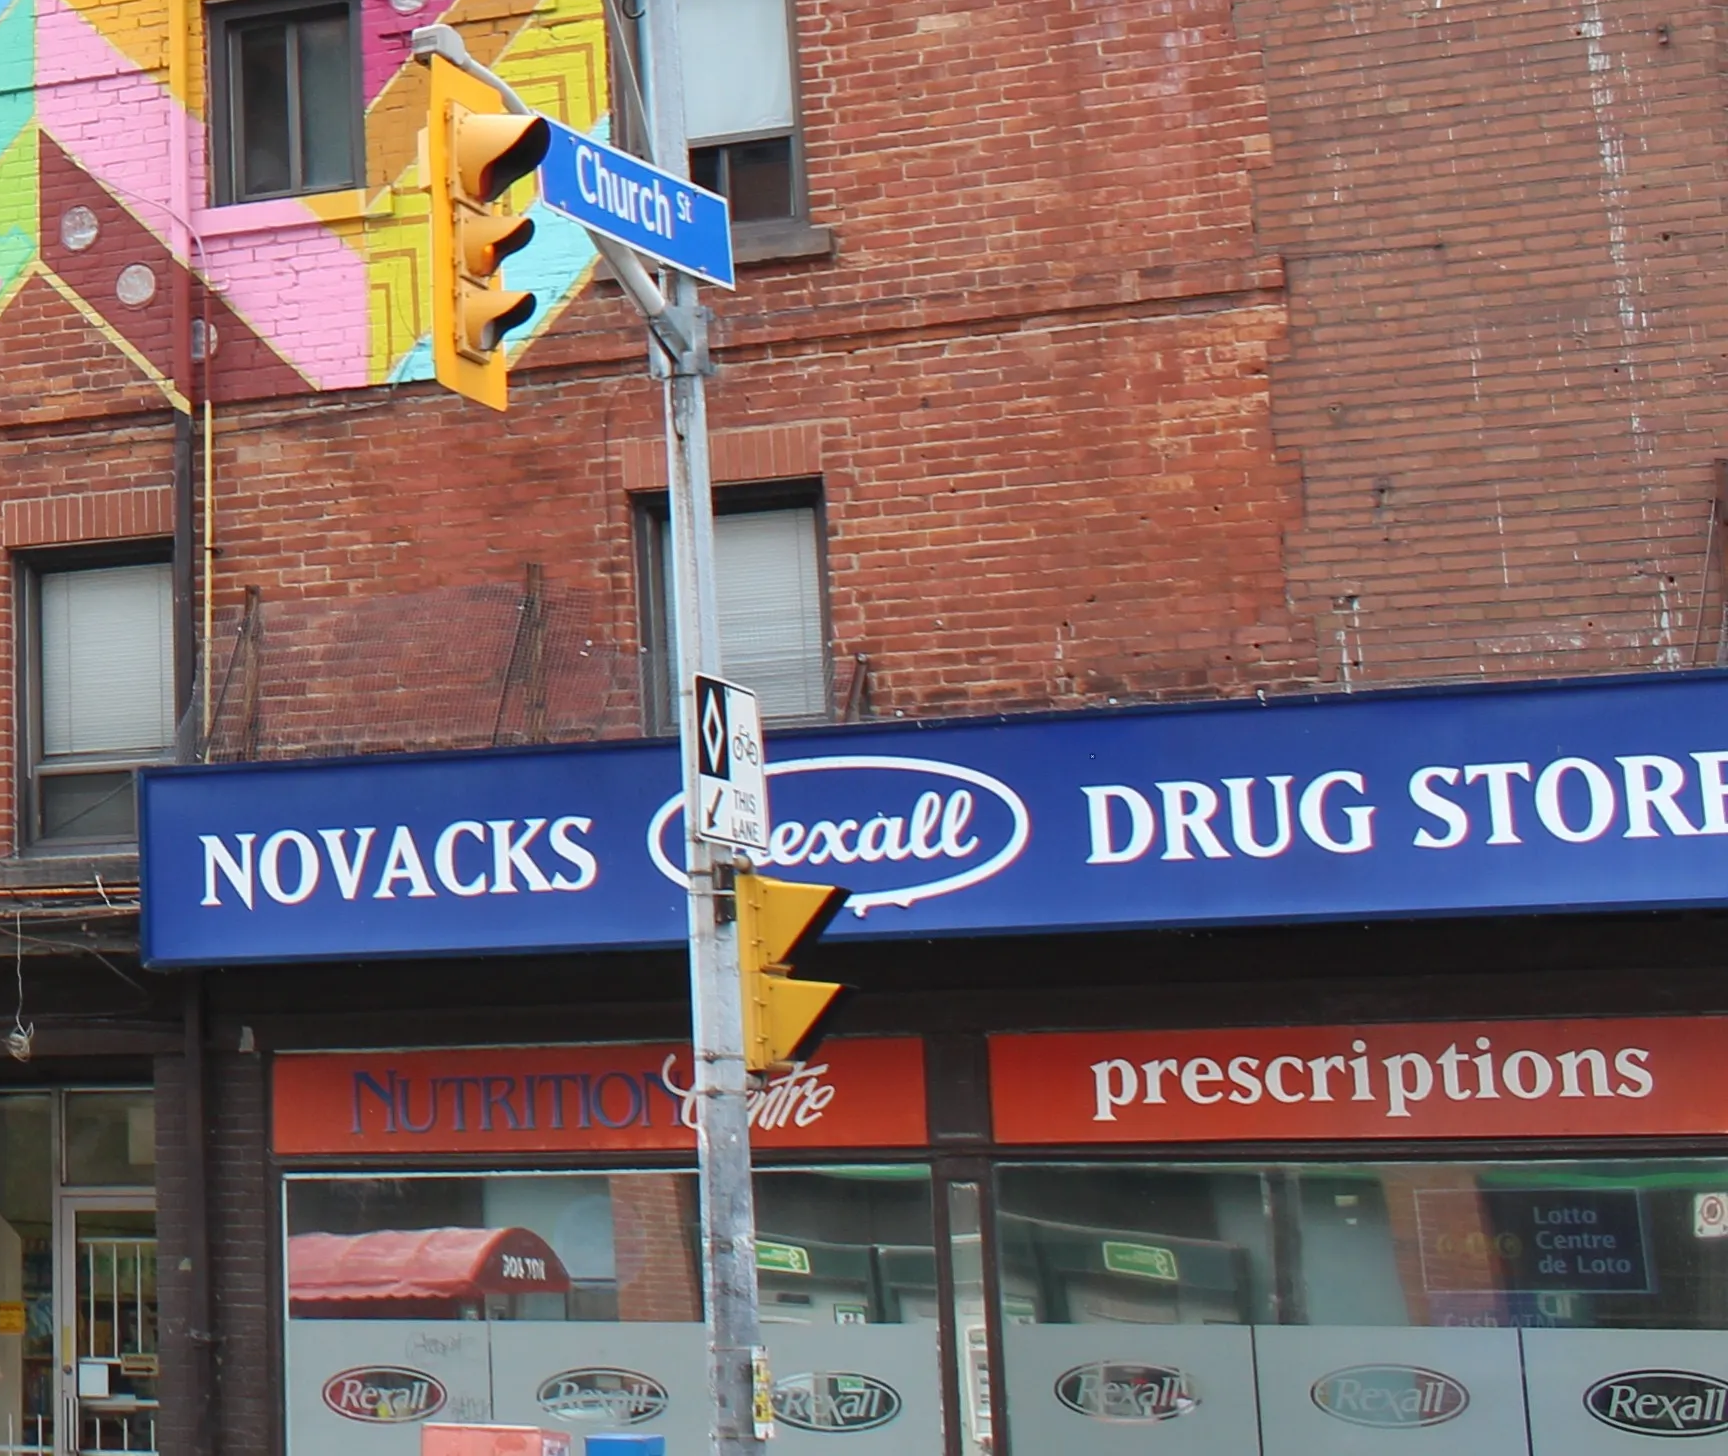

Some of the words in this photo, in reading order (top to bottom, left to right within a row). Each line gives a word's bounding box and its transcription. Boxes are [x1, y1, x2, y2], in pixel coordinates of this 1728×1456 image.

[575, 145, 673, 239] Church
[676, 191, 693, 224] St
[733, 789, 757, 815] THIS
[1080, 770, 1376, 864] DRUG
[731, 817, 761, 843] LANE
[749, 789, 981, 867] exall
[199, 816, 598, 911] NOVACKS
[1090, 1037, 1653, 1122] prescriptions
[350, 1069, 683, 1135] NUTRITION
[1533, 1206, 1597, 1225] Lotto
[1536, 1231, 1616, 1250] Centre
[1539, 1254, 1567, 1274] de
[1578, 1255, 1631, 1274] Loto
[339, 1379, 429, 1416] Rexall
[556, 1382, 650, 1418] Rexall
[785, 1389, 880, 1425] Rexall
[1076, 1374, 1181, 1418] Rexall
[1335, 1379, 1444, 1420] Rexall
[1608, 1385, 1727, 1429] Rexall
